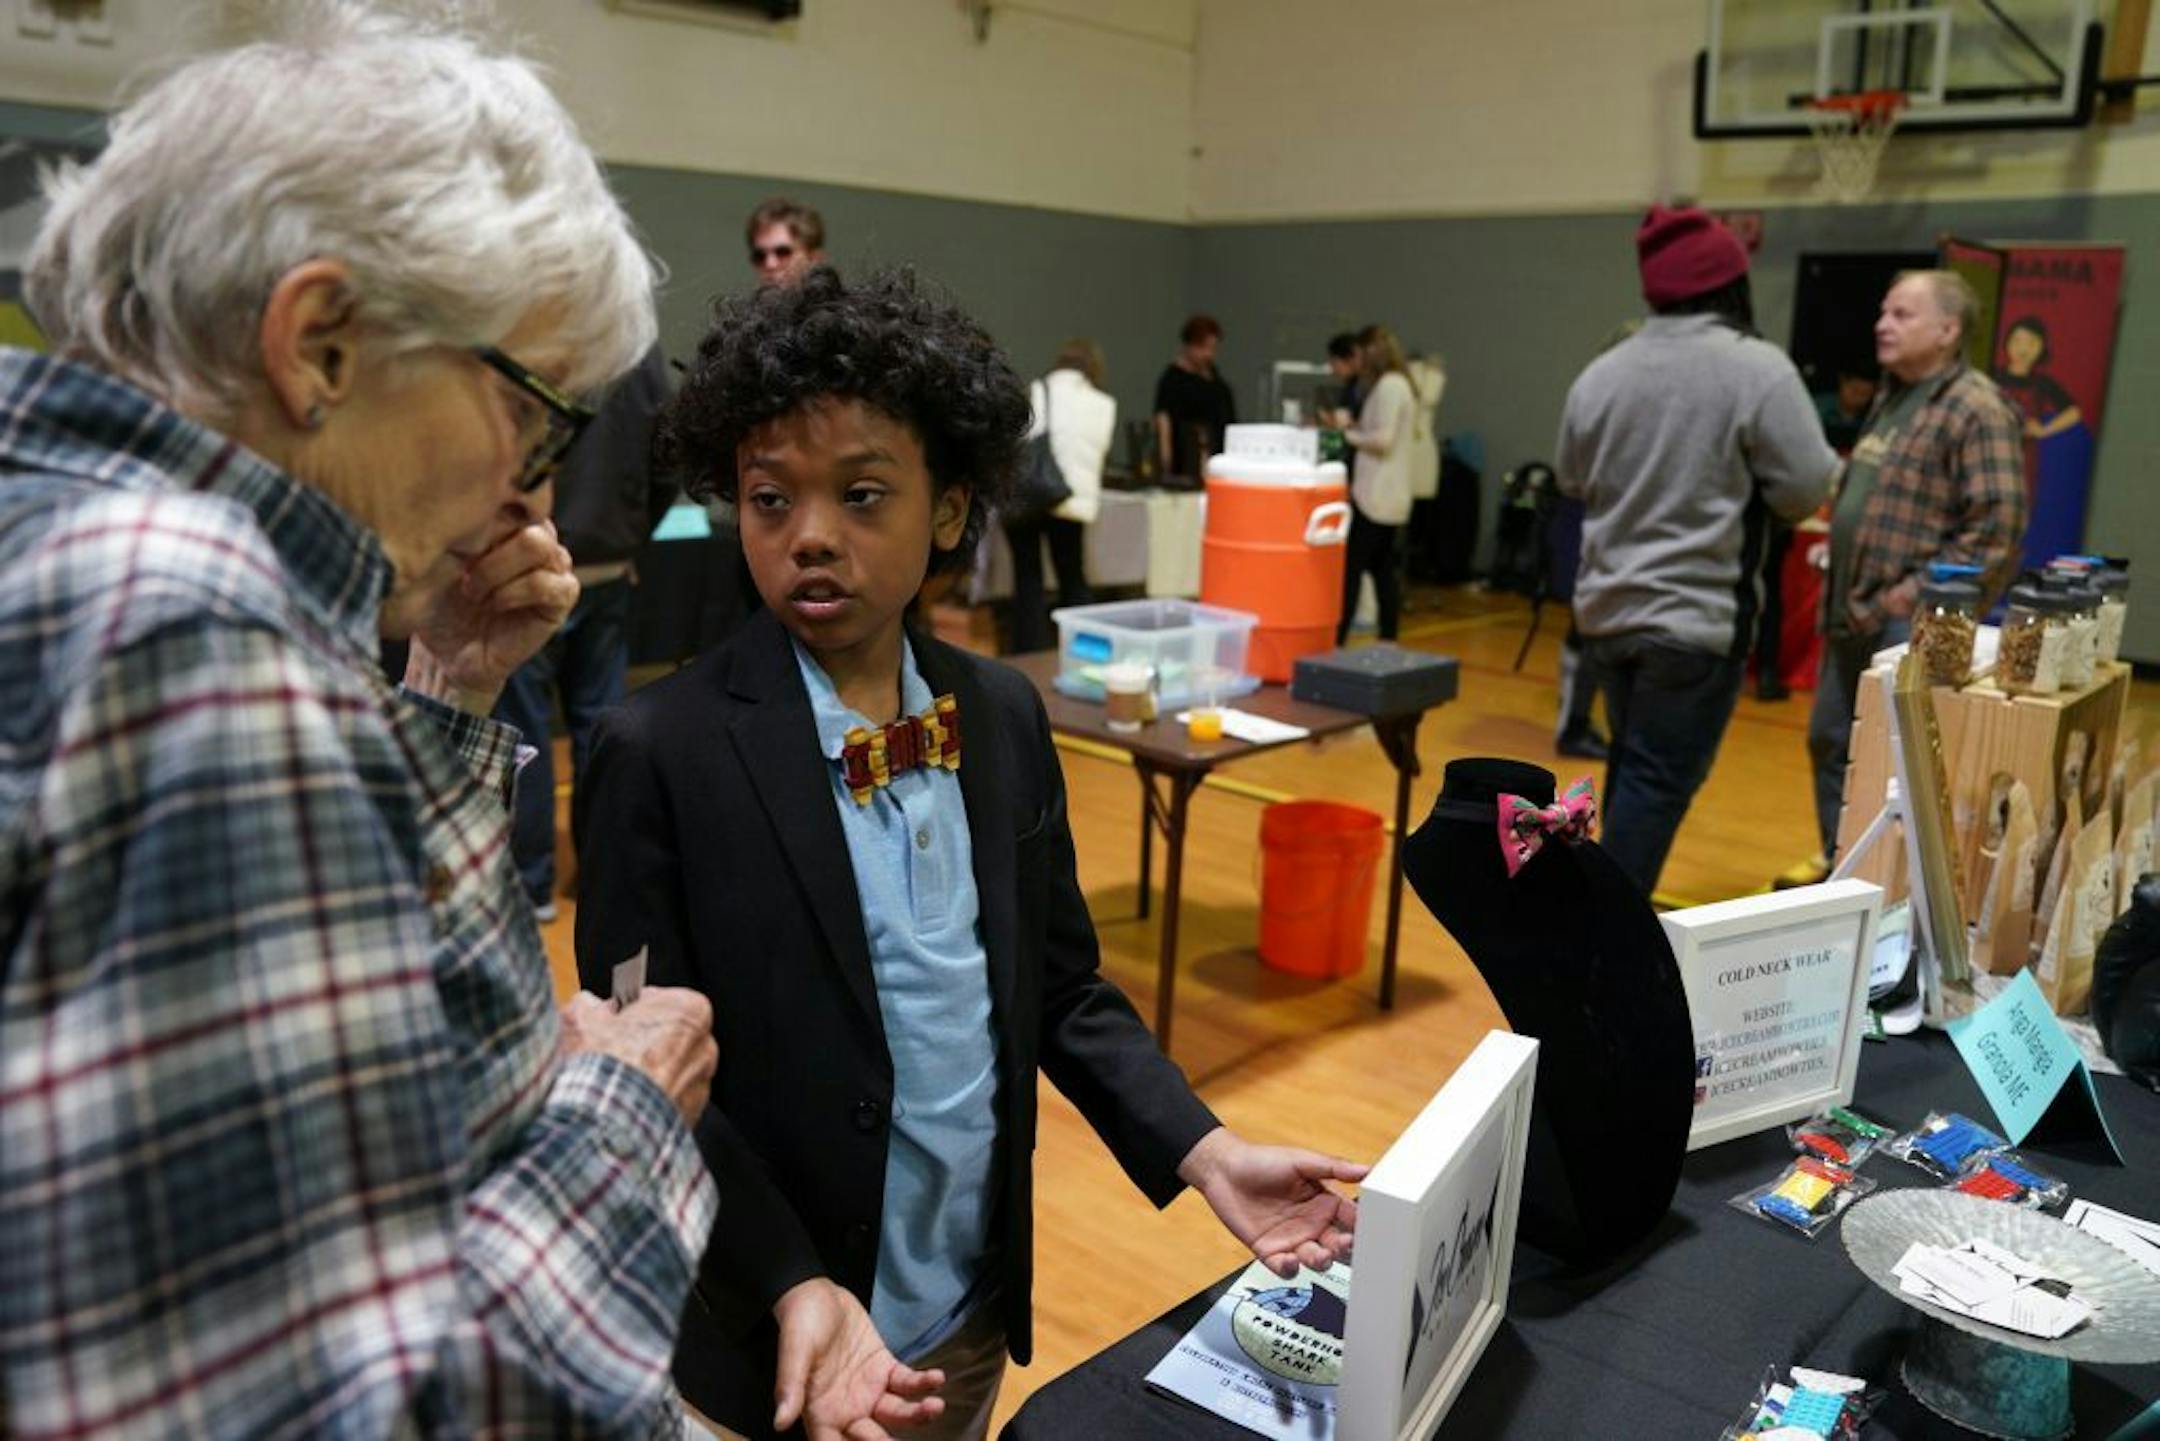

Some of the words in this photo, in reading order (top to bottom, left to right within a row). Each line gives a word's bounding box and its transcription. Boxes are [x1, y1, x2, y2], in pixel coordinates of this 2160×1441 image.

[1717, 968, 1754, 987] COLD
[1755, 957, 1792, 980] NECK
[1795, 950, 1832, 971] WEAR
[1977, 1031, 2013, 1084] Granola
[1252, 1315, 1343, 1358] POWDERHO
[1272, 1338, 1331, 1366] SHARK
[1269, 1350, 1315, 1374] TANK
